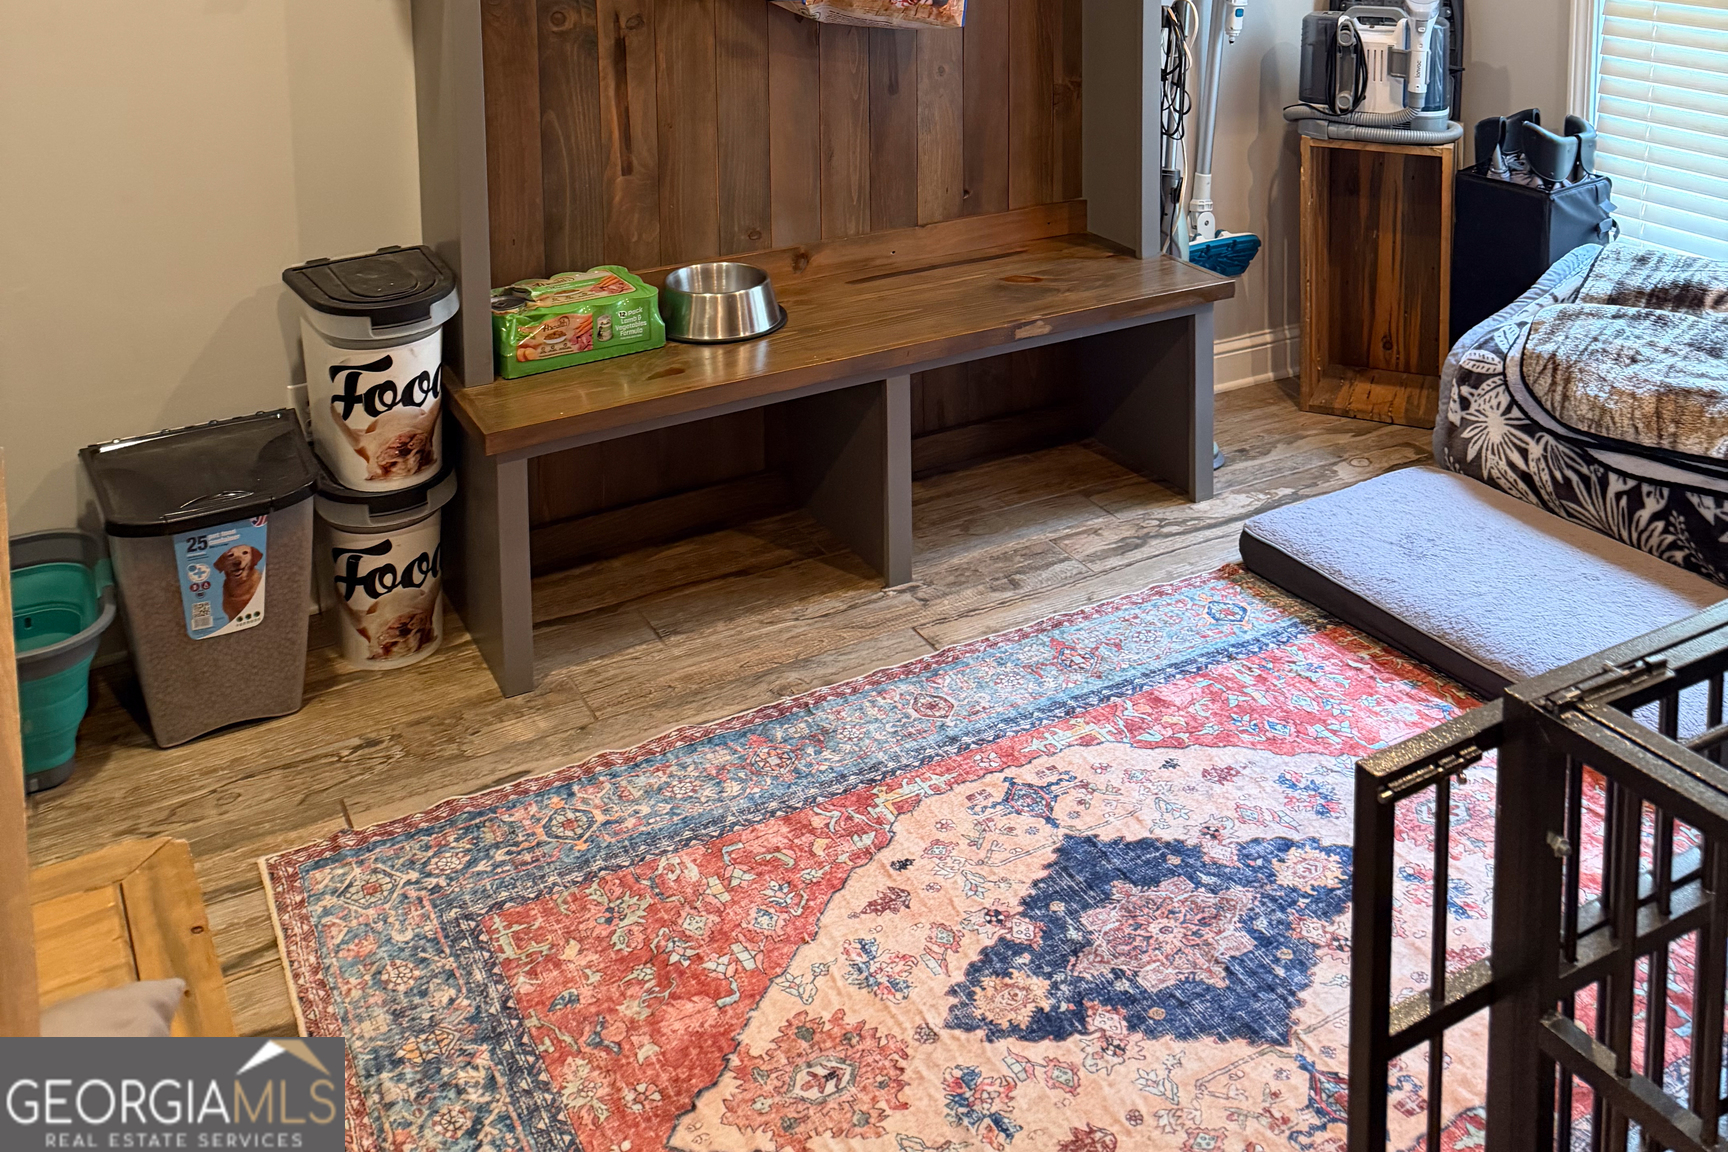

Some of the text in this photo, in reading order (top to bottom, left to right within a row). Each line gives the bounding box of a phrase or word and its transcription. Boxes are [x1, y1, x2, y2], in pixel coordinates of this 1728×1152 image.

[628, 307, 643, 316] Pack
[615, 321, 647, 331] Vegetables
[620, 328, 643, 336] Formula
[186, 535, 208, 553] 25
